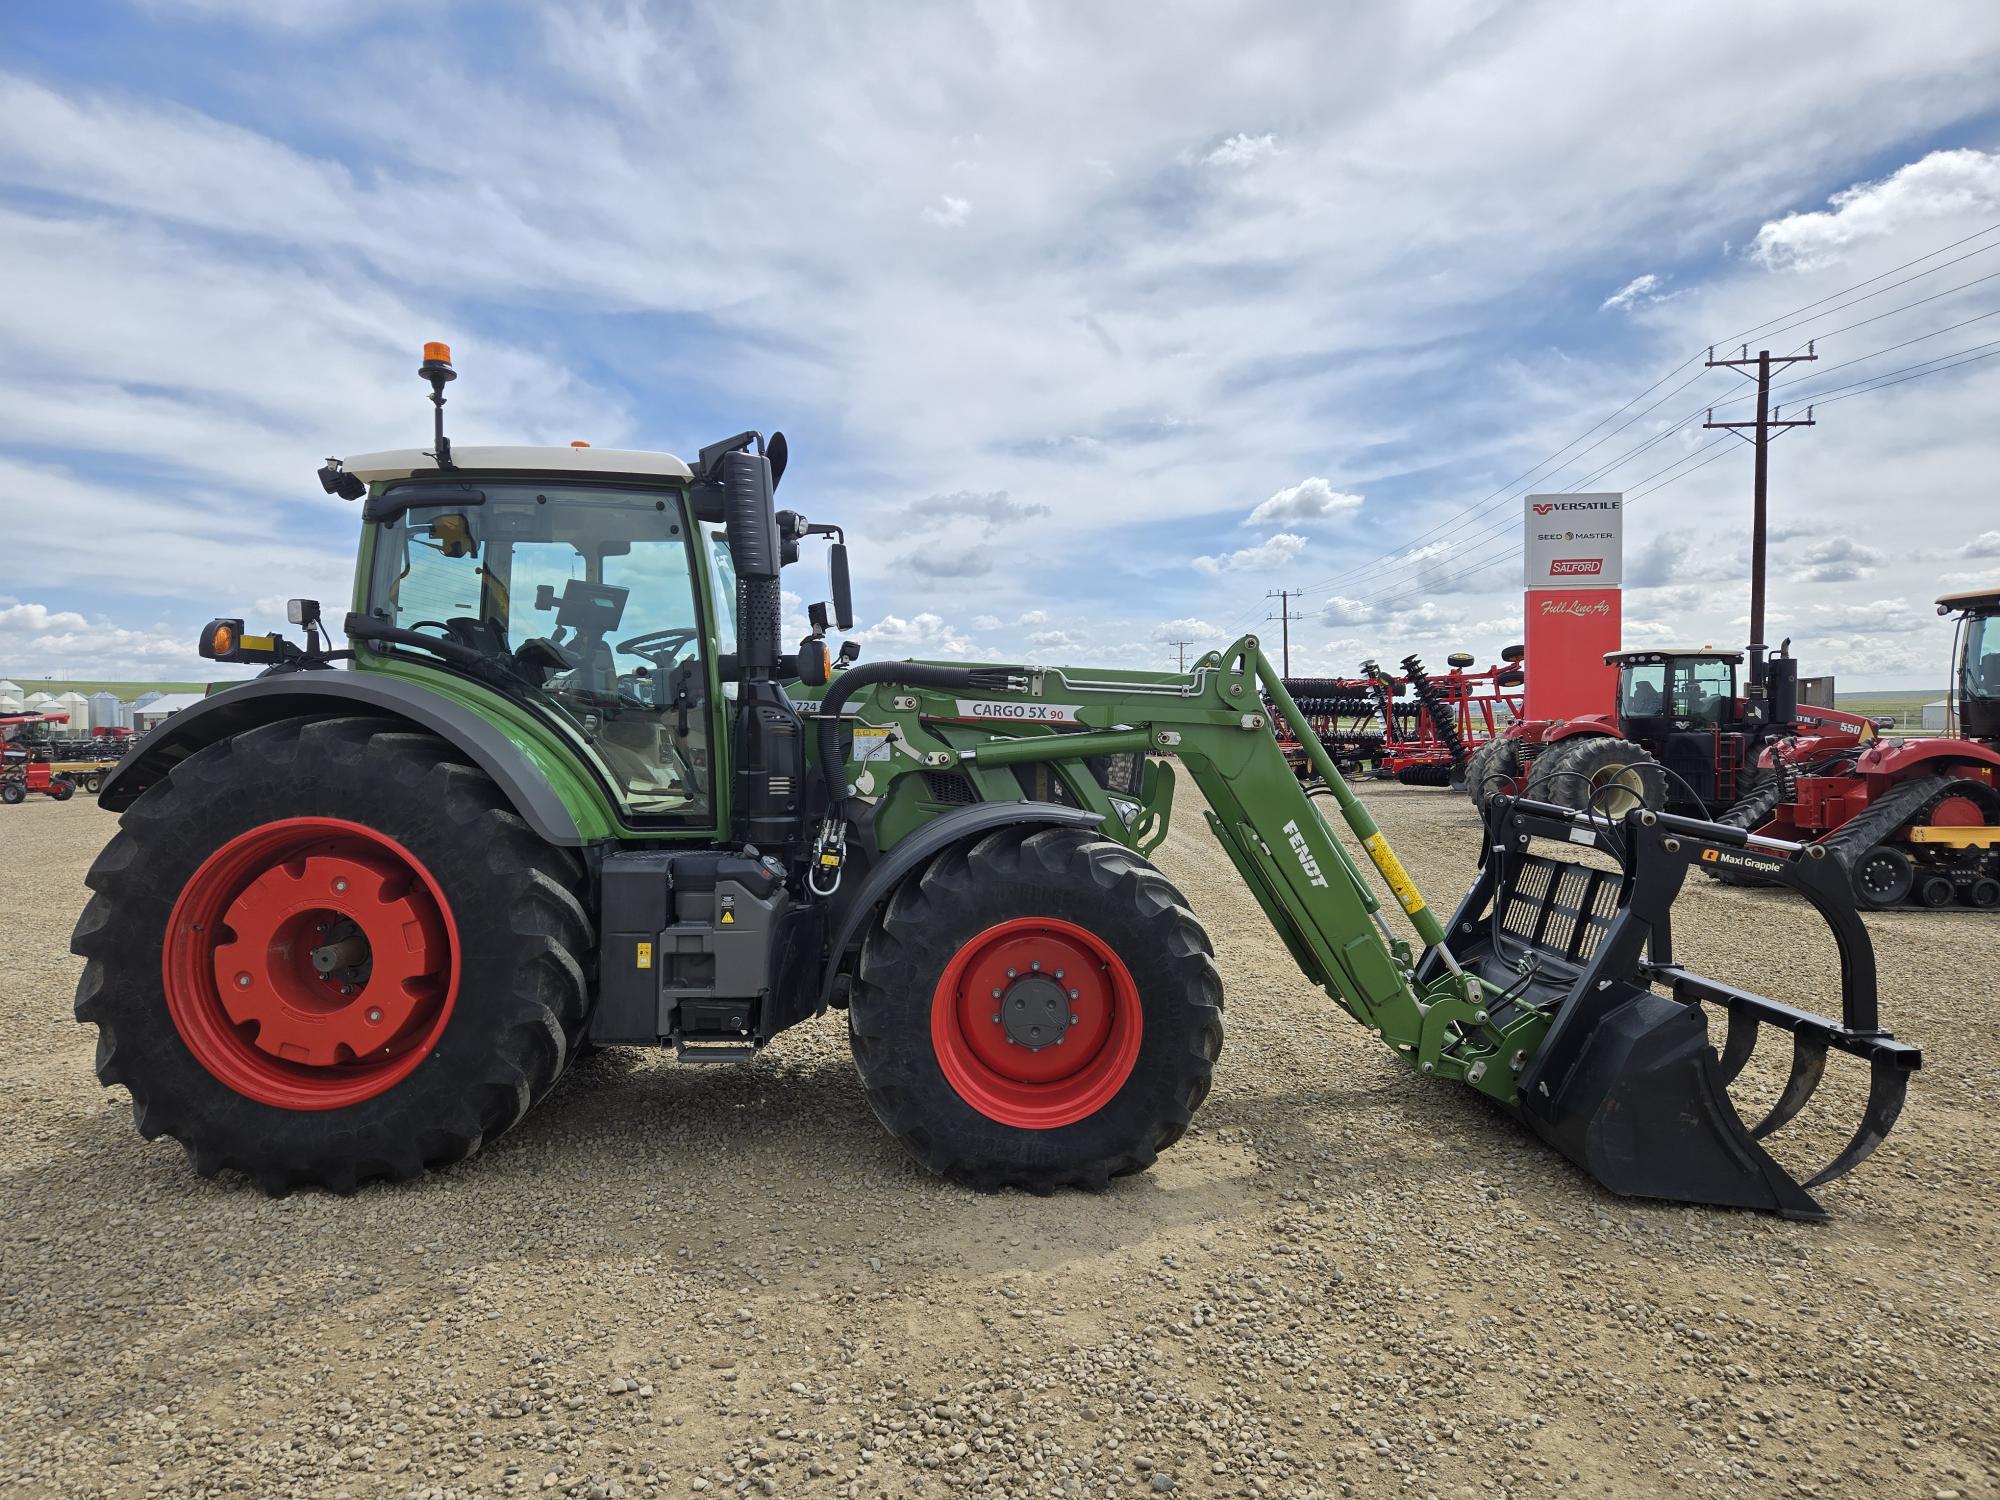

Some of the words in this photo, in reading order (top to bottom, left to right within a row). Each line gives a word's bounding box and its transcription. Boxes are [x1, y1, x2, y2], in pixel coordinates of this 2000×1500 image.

[1553, 501, 1620, 511] VERSATILE
[1575, 532, 1613, 540] MASTER
[1552, 561, 1600, 573] SALFORD
[1541, 600, 1566, 615] Full
[1566, 600, 1592, 616] Line
[1591, 600, 1610, 615] Ag
[796, 702, 817, 712] 724
[972, 703, 1025, 717] CARGO
[1028, 706, 1047, 719] 5X
[1050, 710, 1064, 720] 90
[1840, 722, 1861, 735] 550
[1282, 819, 1329, 889] FENDT
[1720, 853, 1744, 866] Maxi
